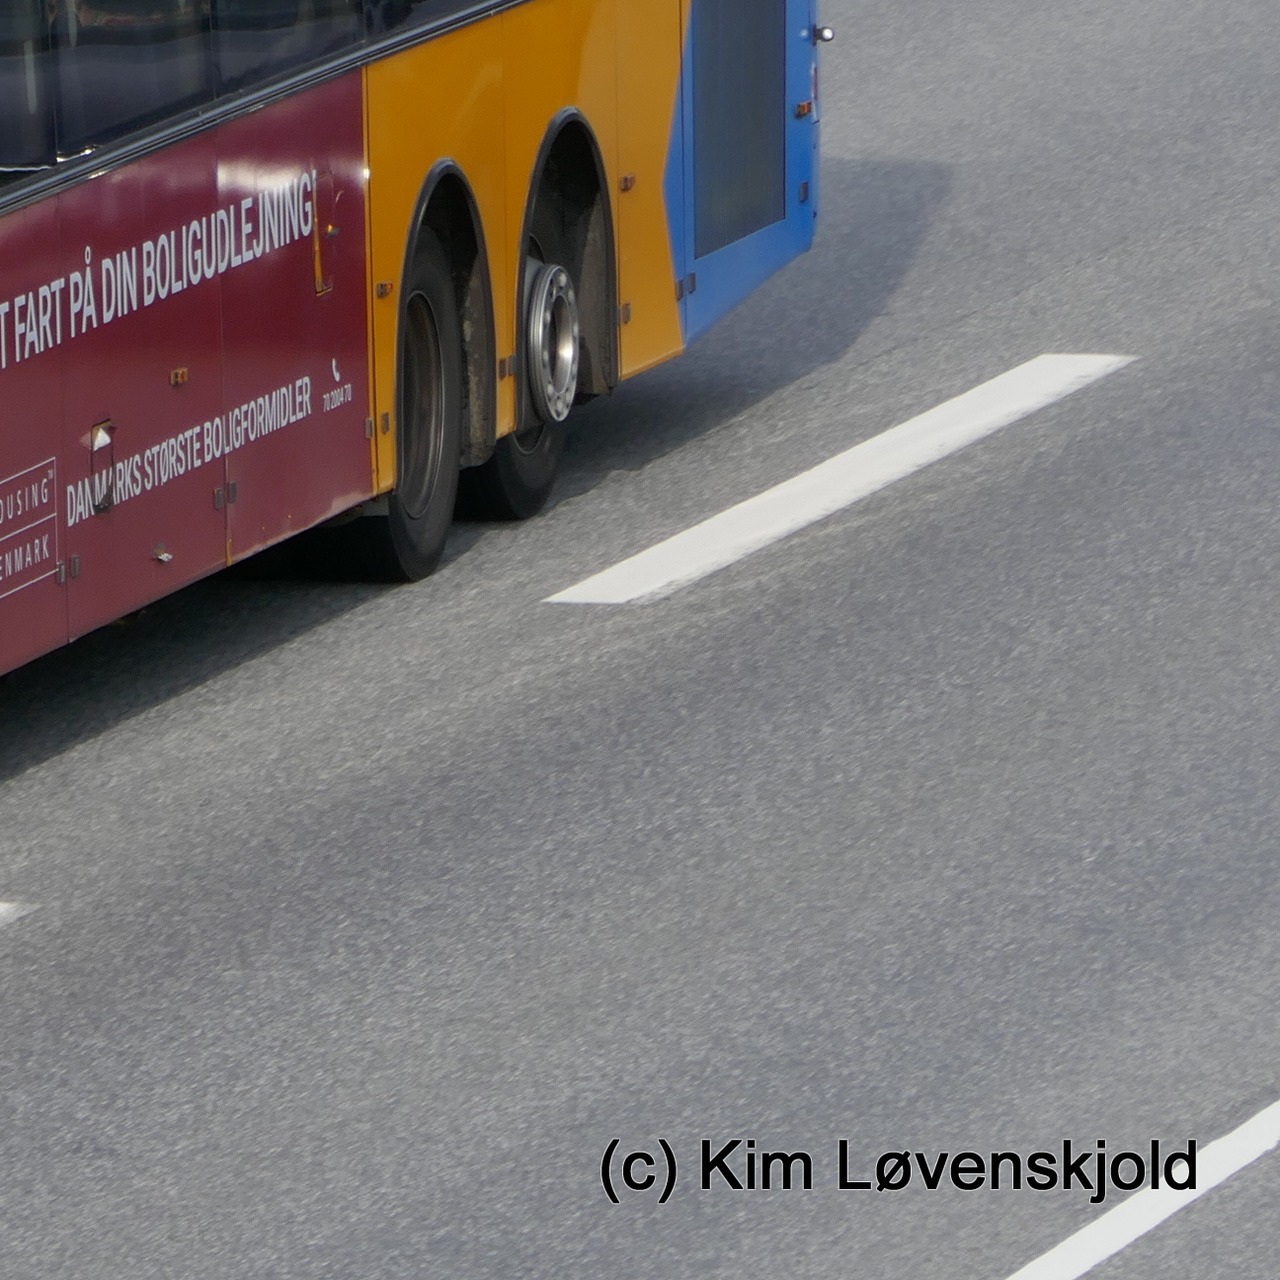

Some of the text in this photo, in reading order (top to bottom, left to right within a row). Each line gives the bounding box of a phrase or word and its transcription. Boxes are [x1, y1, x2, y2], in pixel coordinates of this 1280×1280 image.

[14, 278, 64, 362] FART
[69, 246, 97, 338] PÅ
[102, 247, 138, 324] DIN
[144, 426, 201, 490] STØRSTE
[203, 376, 311, 463] BOLIGFORMIDLER
